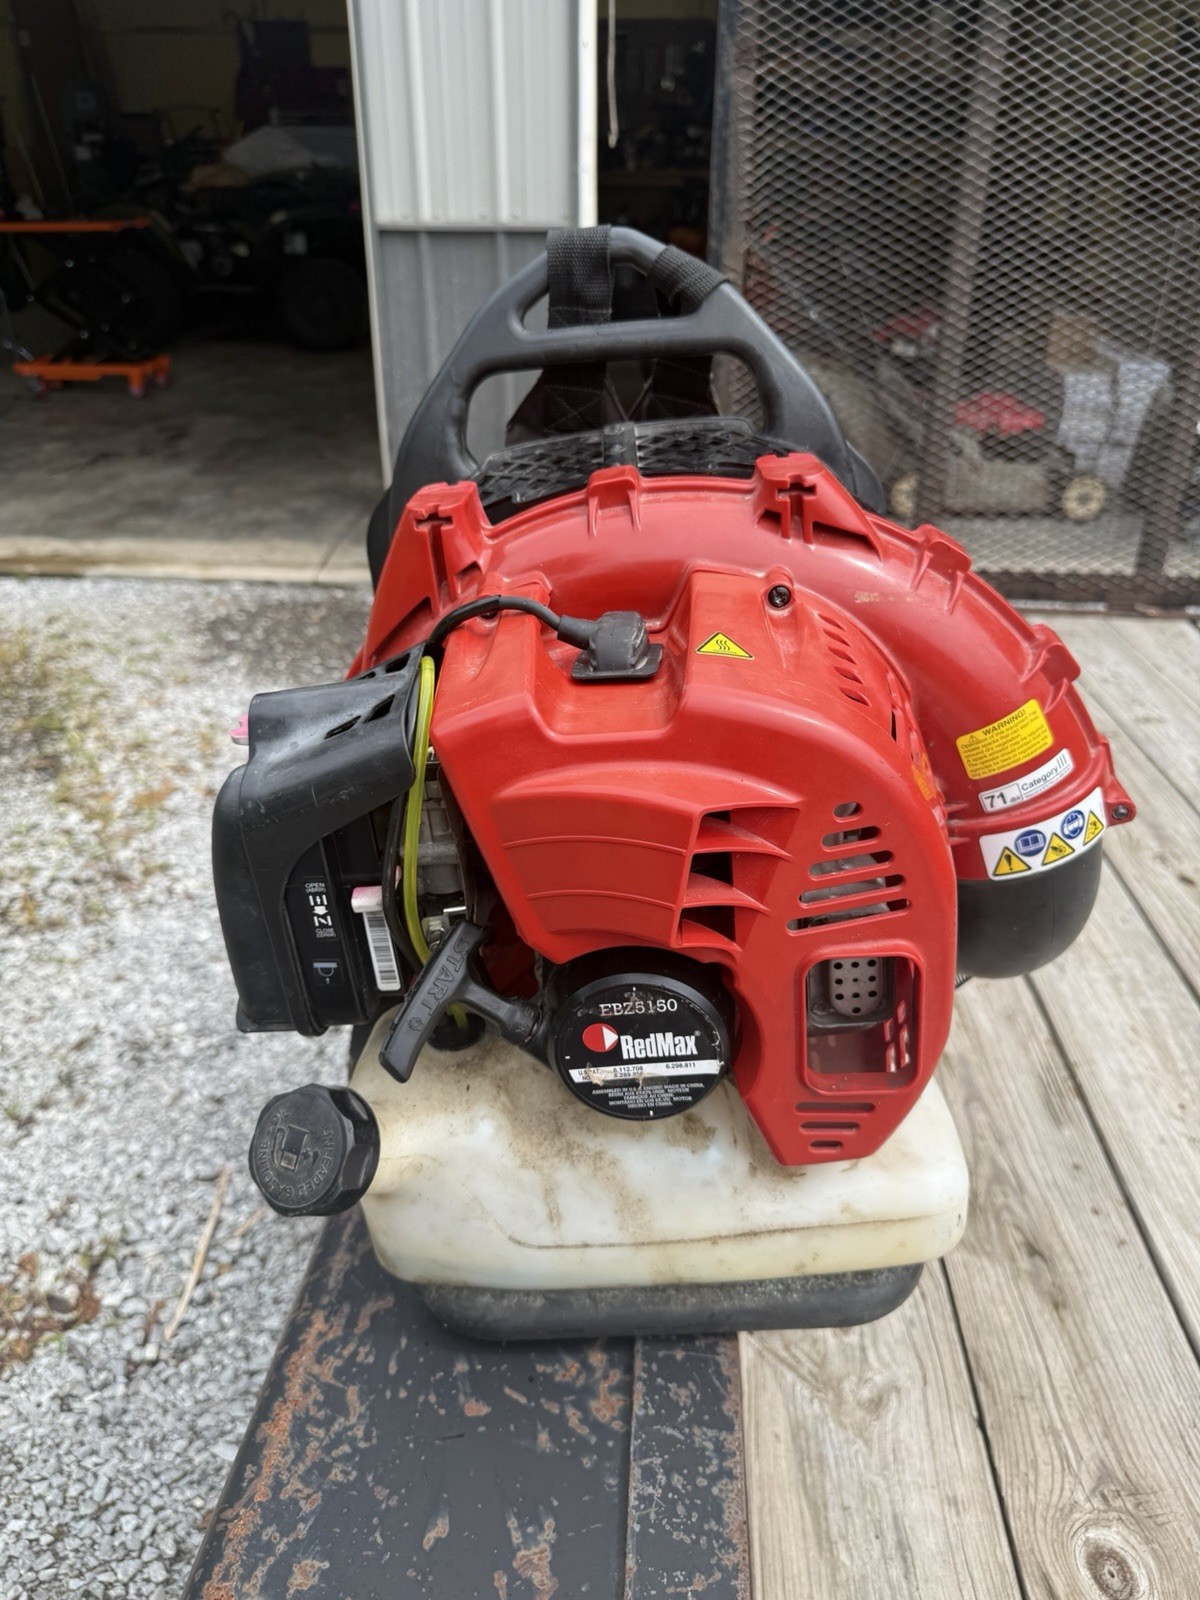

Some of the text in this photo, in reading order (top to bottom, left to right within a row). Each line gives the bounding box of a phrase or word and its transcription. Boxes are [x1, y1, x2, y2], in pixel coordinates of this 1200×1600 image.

[982, 709, 1025, 736] WARNING!
[984, 791, 1009, 808] 71
[1021, 766, 1059, 791] Category
[421, 939, 471, 1017] START
[599, 998, 678, 1017] EBZ5150
